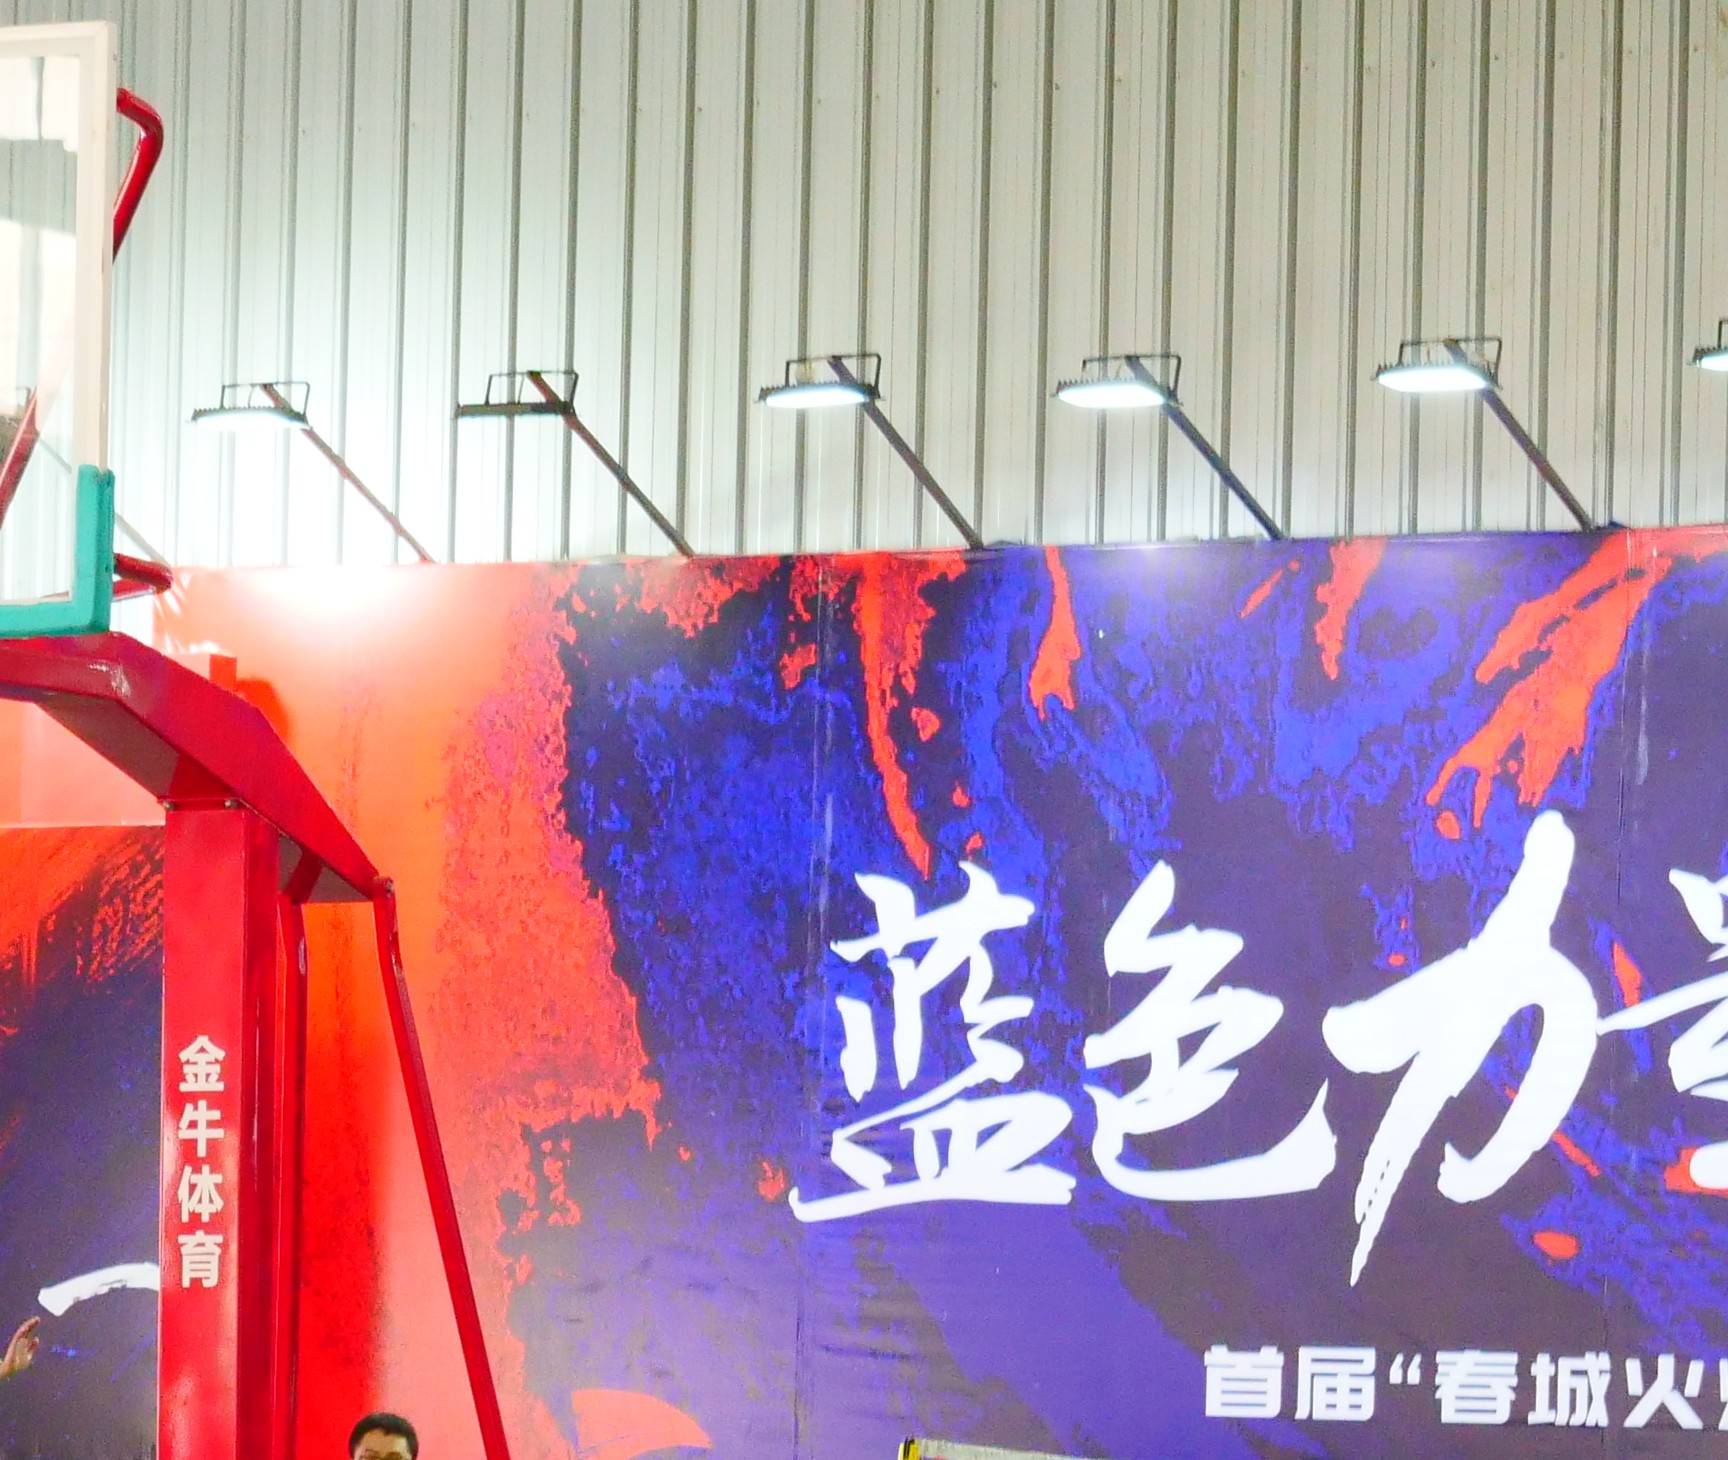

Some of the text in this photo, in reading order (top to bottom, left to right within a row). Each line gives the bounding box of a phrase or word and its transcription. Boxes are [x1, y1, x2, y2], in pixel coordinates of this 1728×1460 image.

[178, 1035, 226, 1288] 金牛体育
[1204, 1345, 1728, 1431] 首届“春城火
